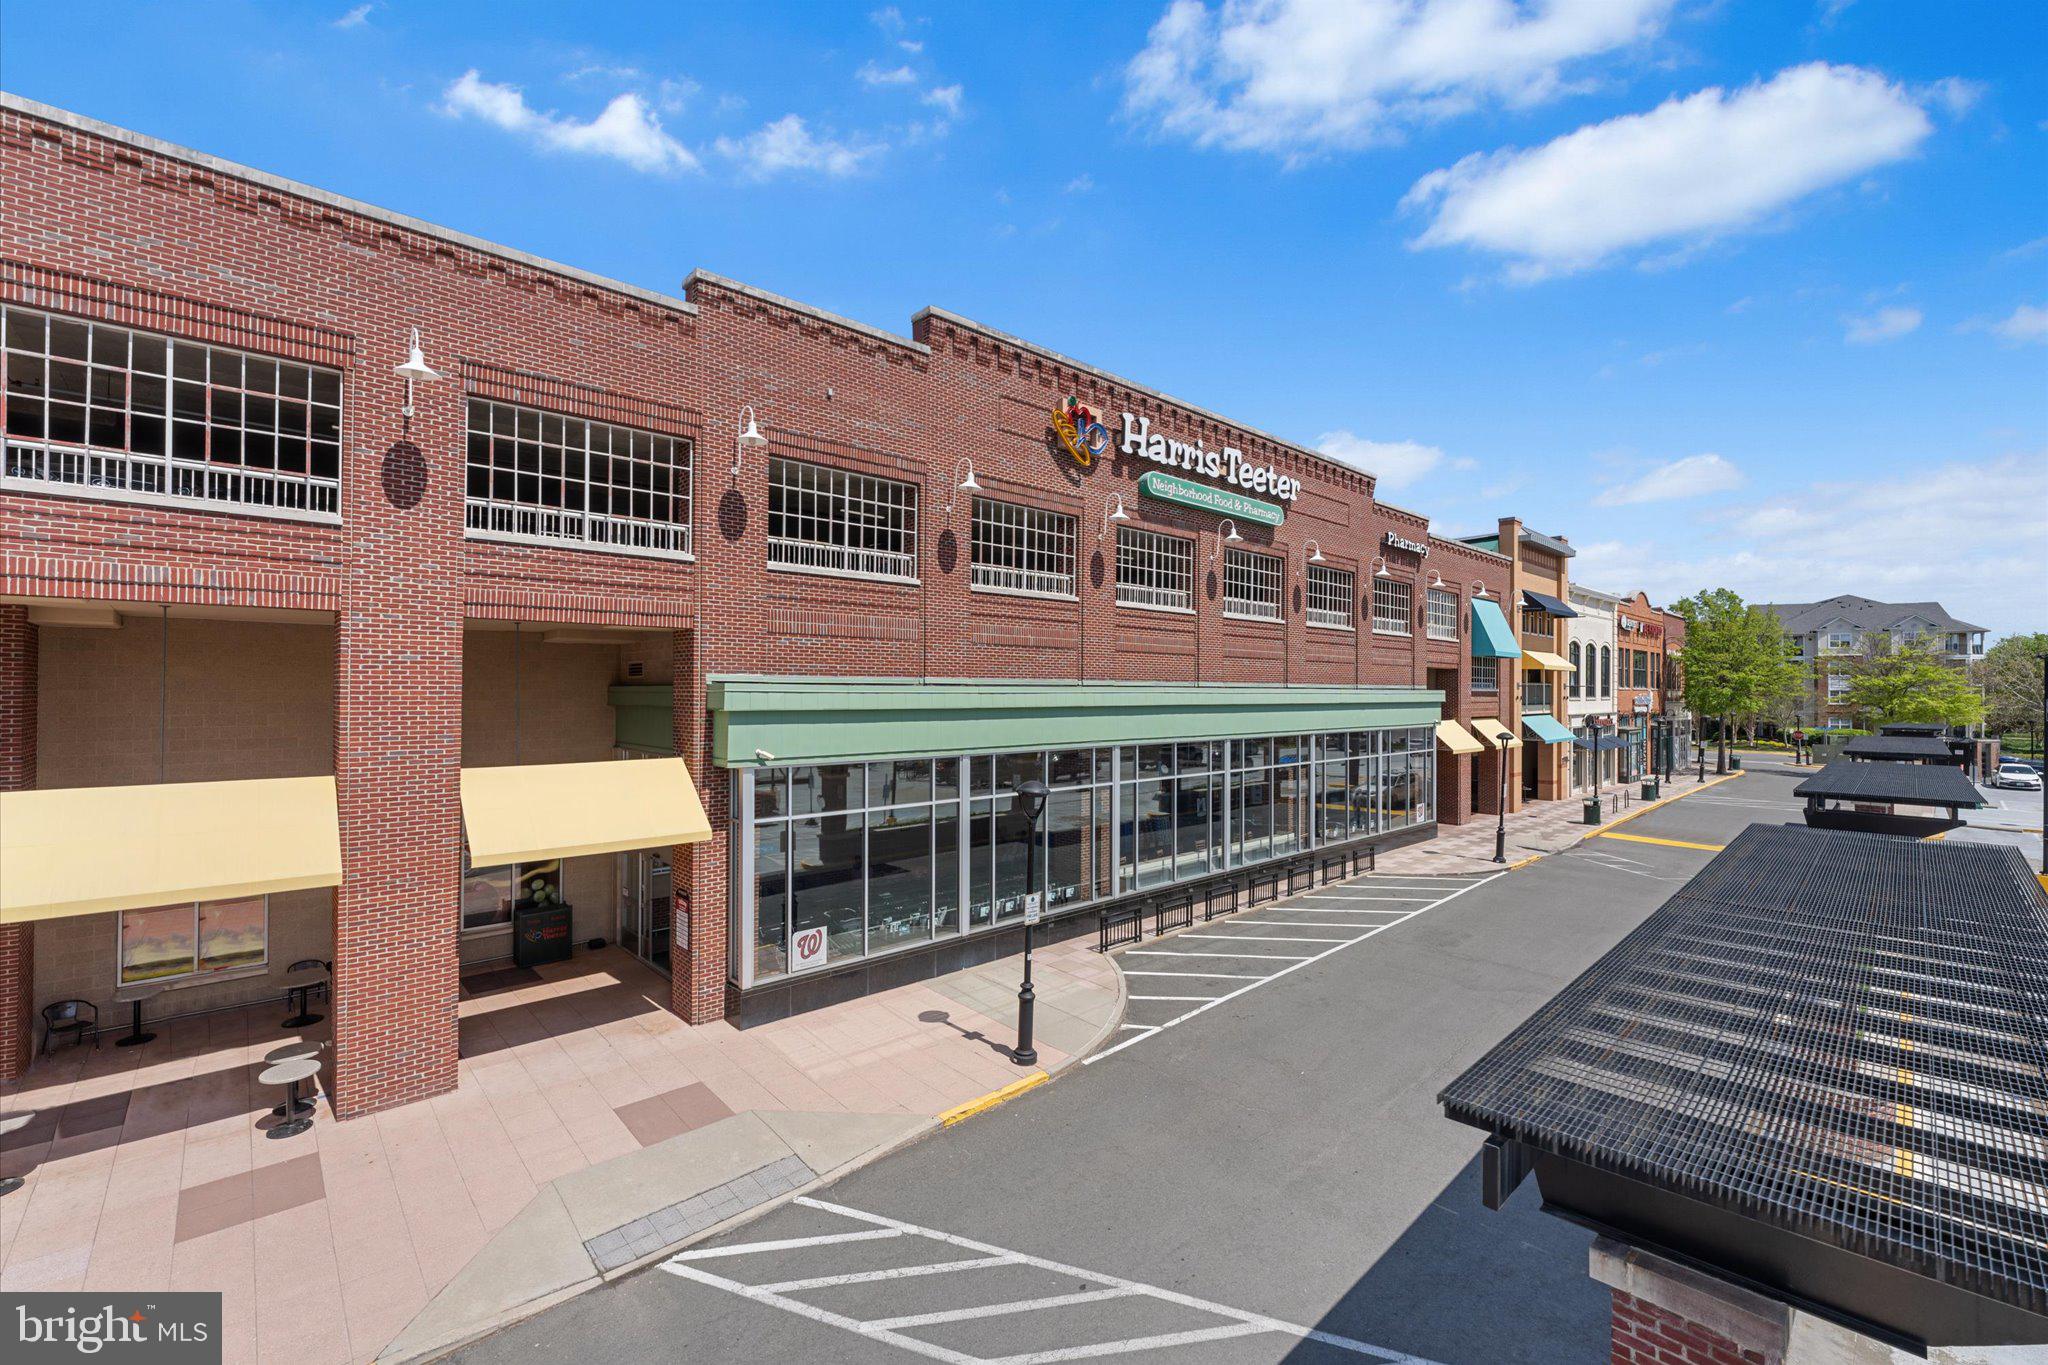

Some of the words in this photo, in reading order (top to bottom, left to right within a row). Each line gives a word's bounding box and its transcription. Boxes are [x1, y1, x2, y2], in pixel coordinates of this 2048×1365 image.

[1121, 412, 1220, 479] Harris
[1223, 447, 1300, 501] Teeter
[1152, 477, 1213, 504] Neighborhood
[1214, 494, 1233, 509] Food
[1235, 499, 1242, 511] &
[1243, 502, 1280, 522] Pharmacy
[1388, 531, 1430, 558] Pharmacy
